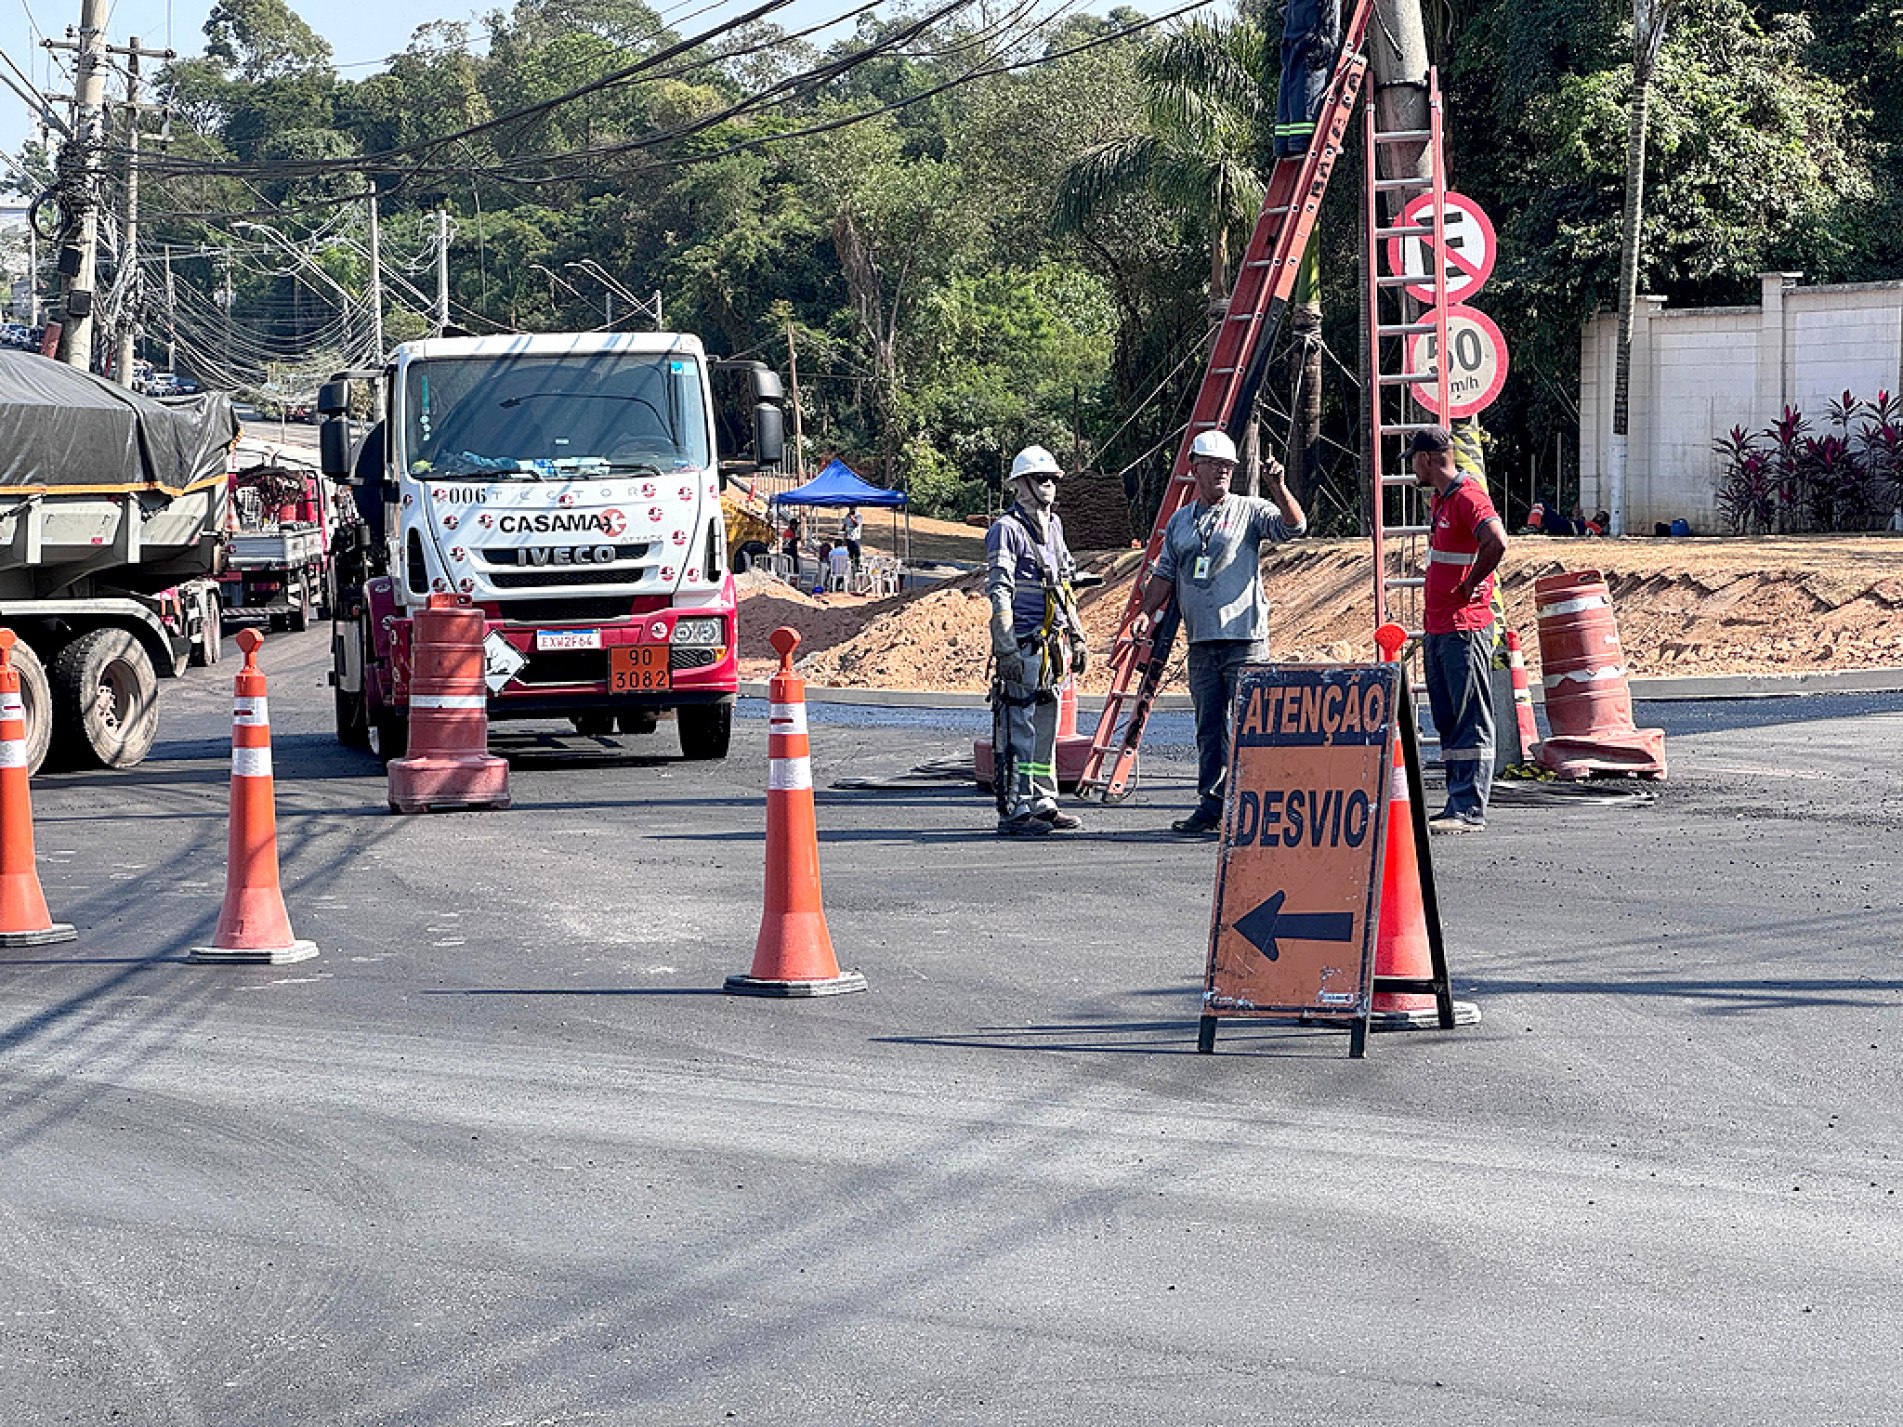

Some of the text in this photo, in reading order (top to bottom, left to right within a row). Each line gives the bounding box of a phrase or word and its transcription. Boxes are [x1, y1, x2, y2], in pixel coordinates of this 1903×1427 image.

[1448, 376, 1480, 393] m/h
[449, 486, 487, 504] 006
[517, 545, 616, 567] IVECO
[630, 649, 652, 665] 90
[616, 670, 666, 688] 3082
[1241, 675, 1386, 746] ATENÇÃO
[1235, 789, 1370, 849] DESVIO
